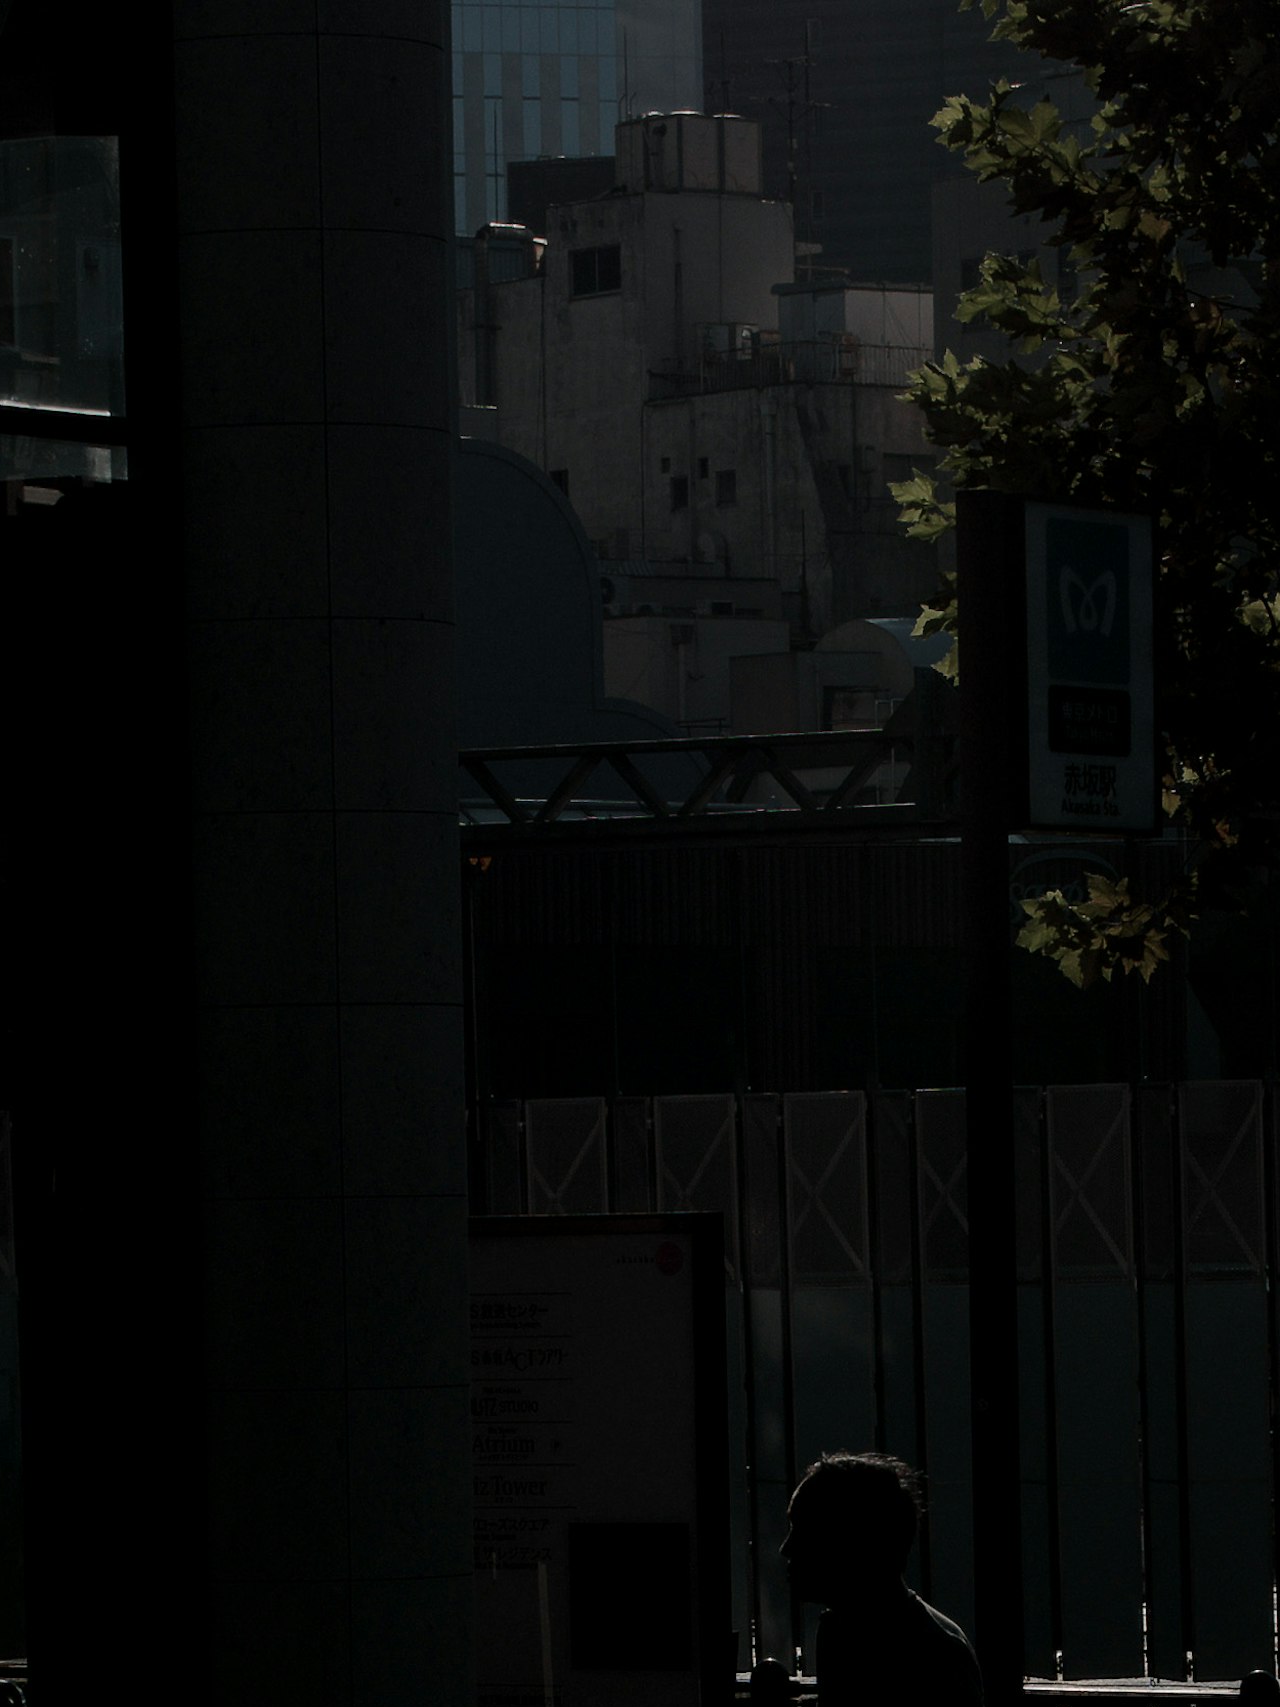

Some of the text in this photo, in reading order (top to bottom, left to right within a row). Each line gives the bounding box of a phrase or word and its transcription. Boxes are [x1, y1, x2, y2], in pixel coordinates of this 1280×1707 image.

[1064, 763, 1117, 798] 赤坂駅
[1061, 799, 1100, 815] Akasaka
[472, 1435, 534, 1452] Atrium
[489, 1475, 547, 1496] Tower
